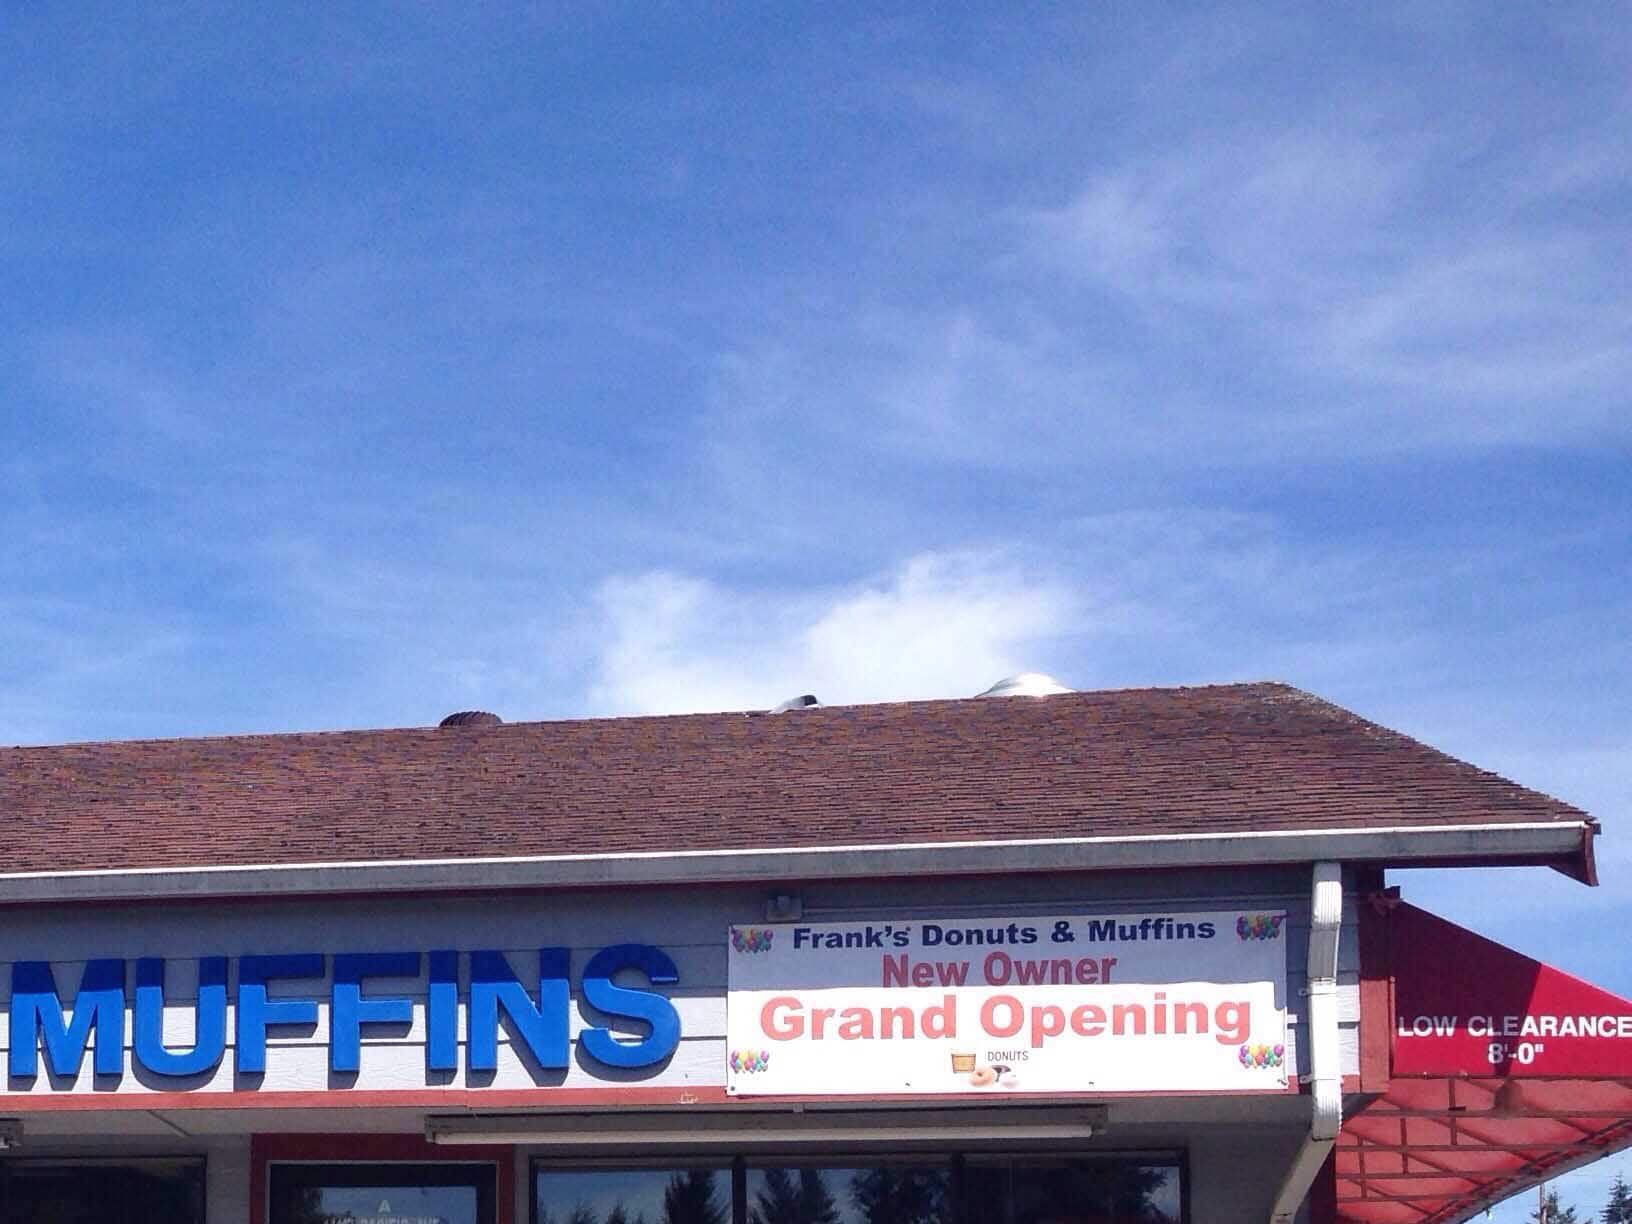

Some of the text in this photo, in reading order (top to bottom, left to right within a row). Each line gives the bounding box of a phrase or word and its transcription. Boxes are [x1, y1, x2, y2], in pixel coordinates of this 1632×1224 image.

[793, 916, 1216, 950] Frank's Donuts & Muffins
[882, 951, 1117, 988] New Owner
[8, 944, 681, 1077] MUFFINS
[759, 991, 1251, 1048] Grand Opening
[1398, 1015, 1632, 1038] LOW CLEARANCE
[988, 1050, 1029, 1062] DONUTS
